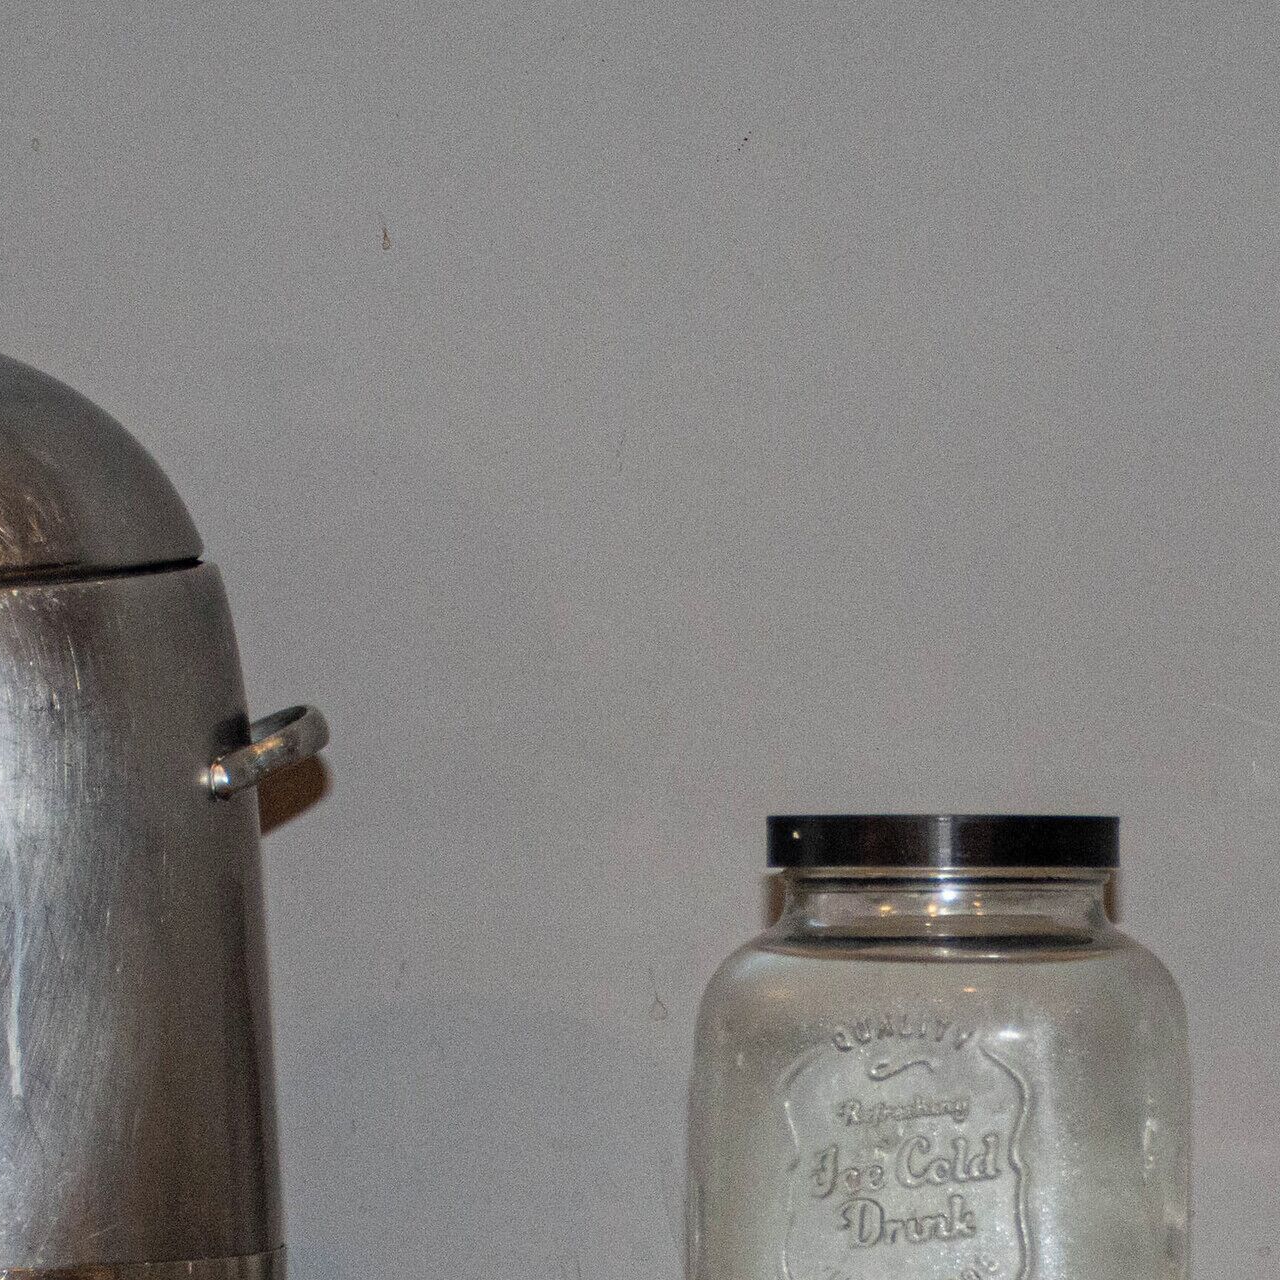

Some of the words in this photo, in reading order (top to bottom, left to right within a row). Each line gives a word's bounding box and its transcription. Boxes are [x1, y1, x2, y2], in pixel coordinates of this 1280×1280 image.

[830, 1013, 975, 1051] QUALITY
[809, 1142, 886, 1199] Ice
[894, 1131, 1002, 1190] Cold
[835, 1193, 978, 1248] Drink
